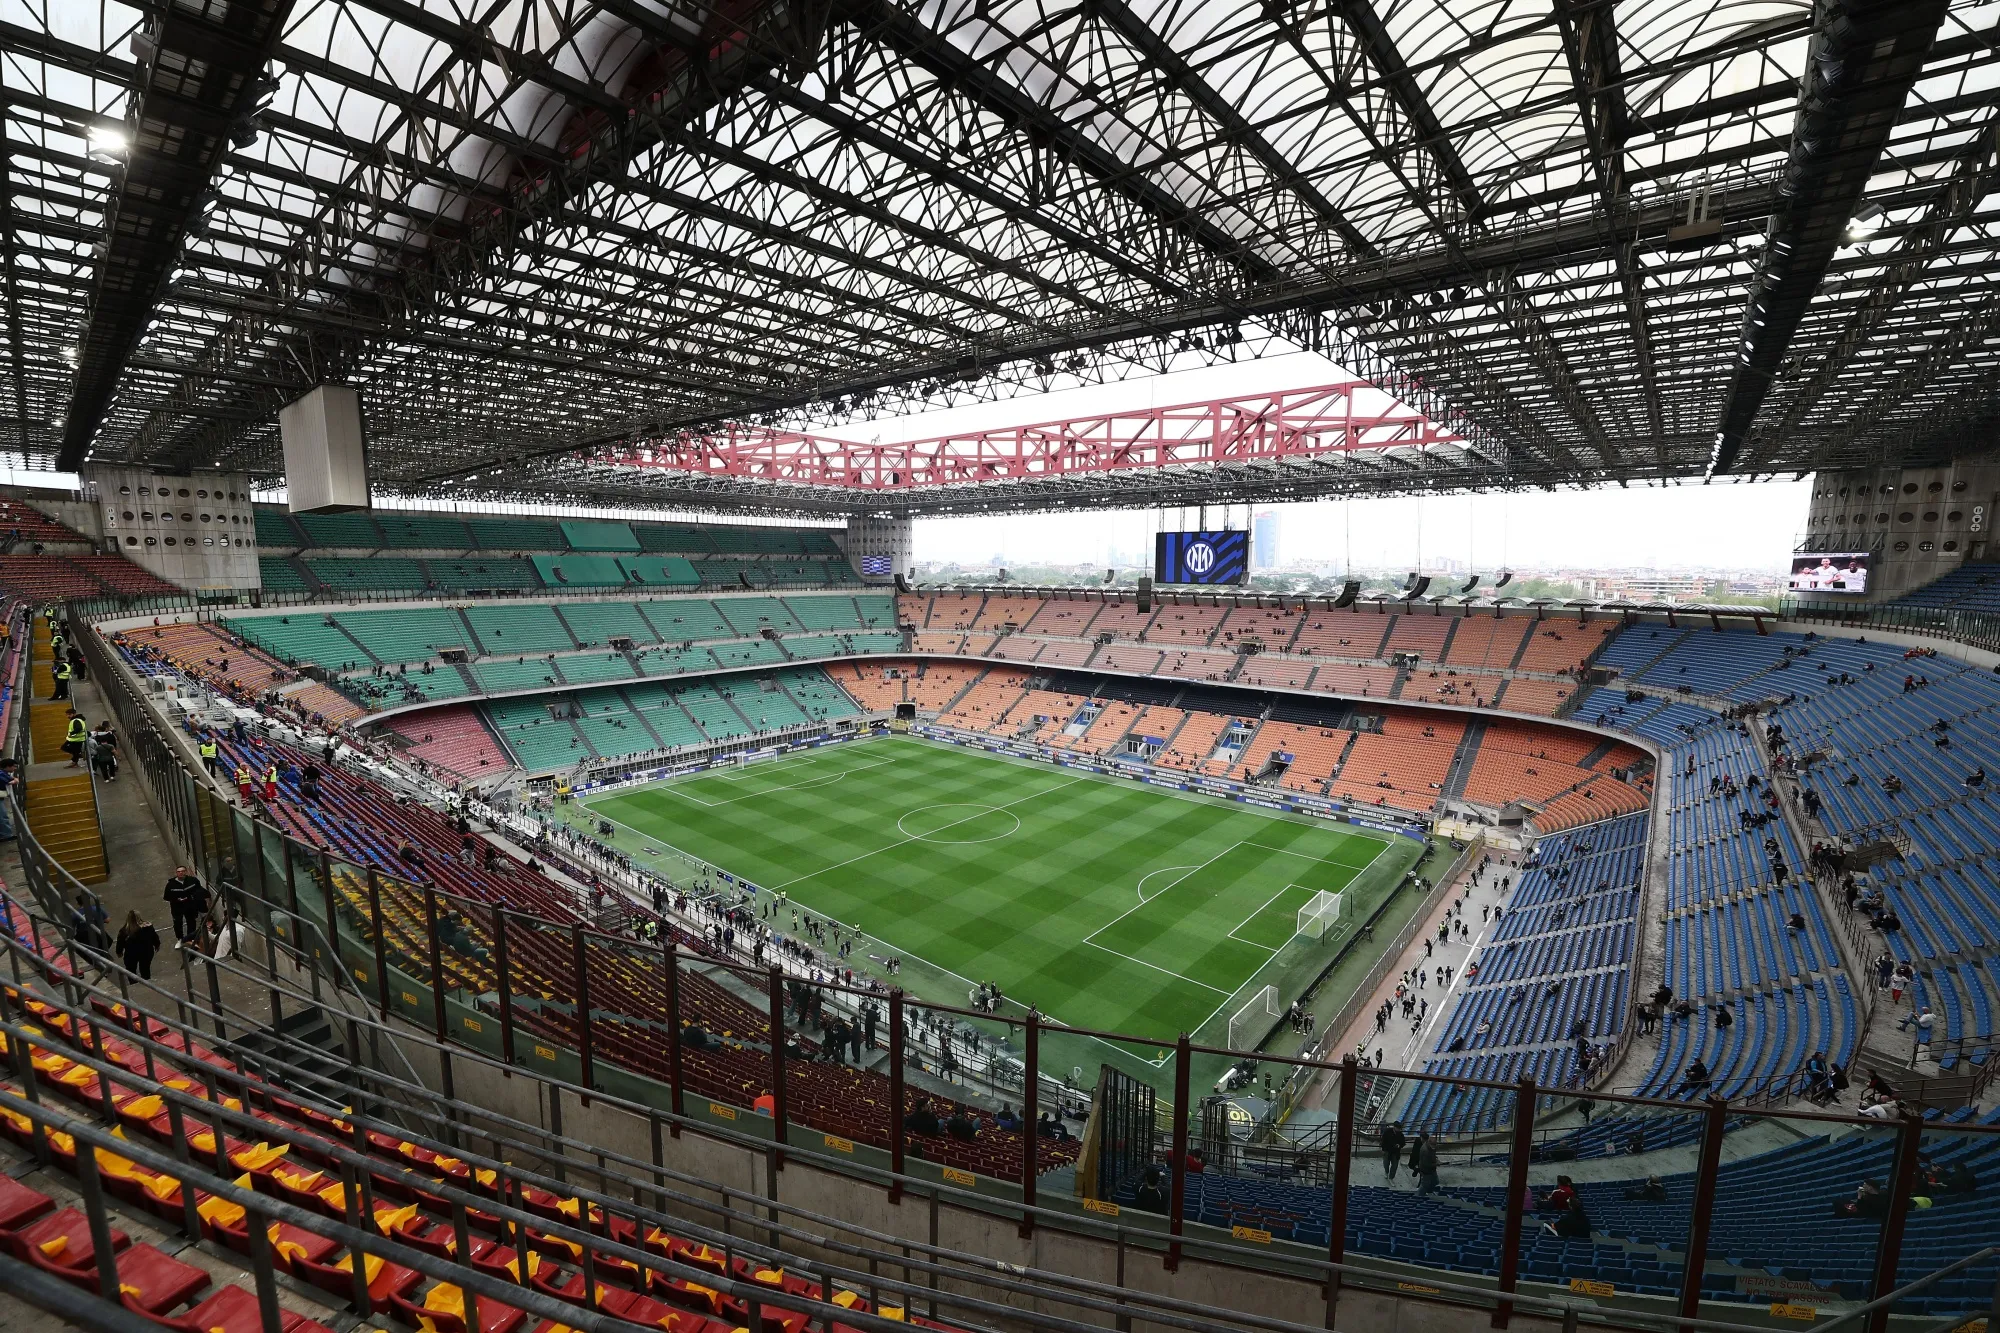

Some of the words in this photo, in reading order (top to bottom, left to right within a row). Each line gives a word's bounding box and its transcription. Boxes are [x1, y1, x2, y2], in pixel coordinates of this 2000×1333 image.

[1740, 1276, 1776, 1287] VIETATO
[1746, 1288, 1759, 1297] NO
[1764, 1290, 1830, 1304] TRESPASSING
